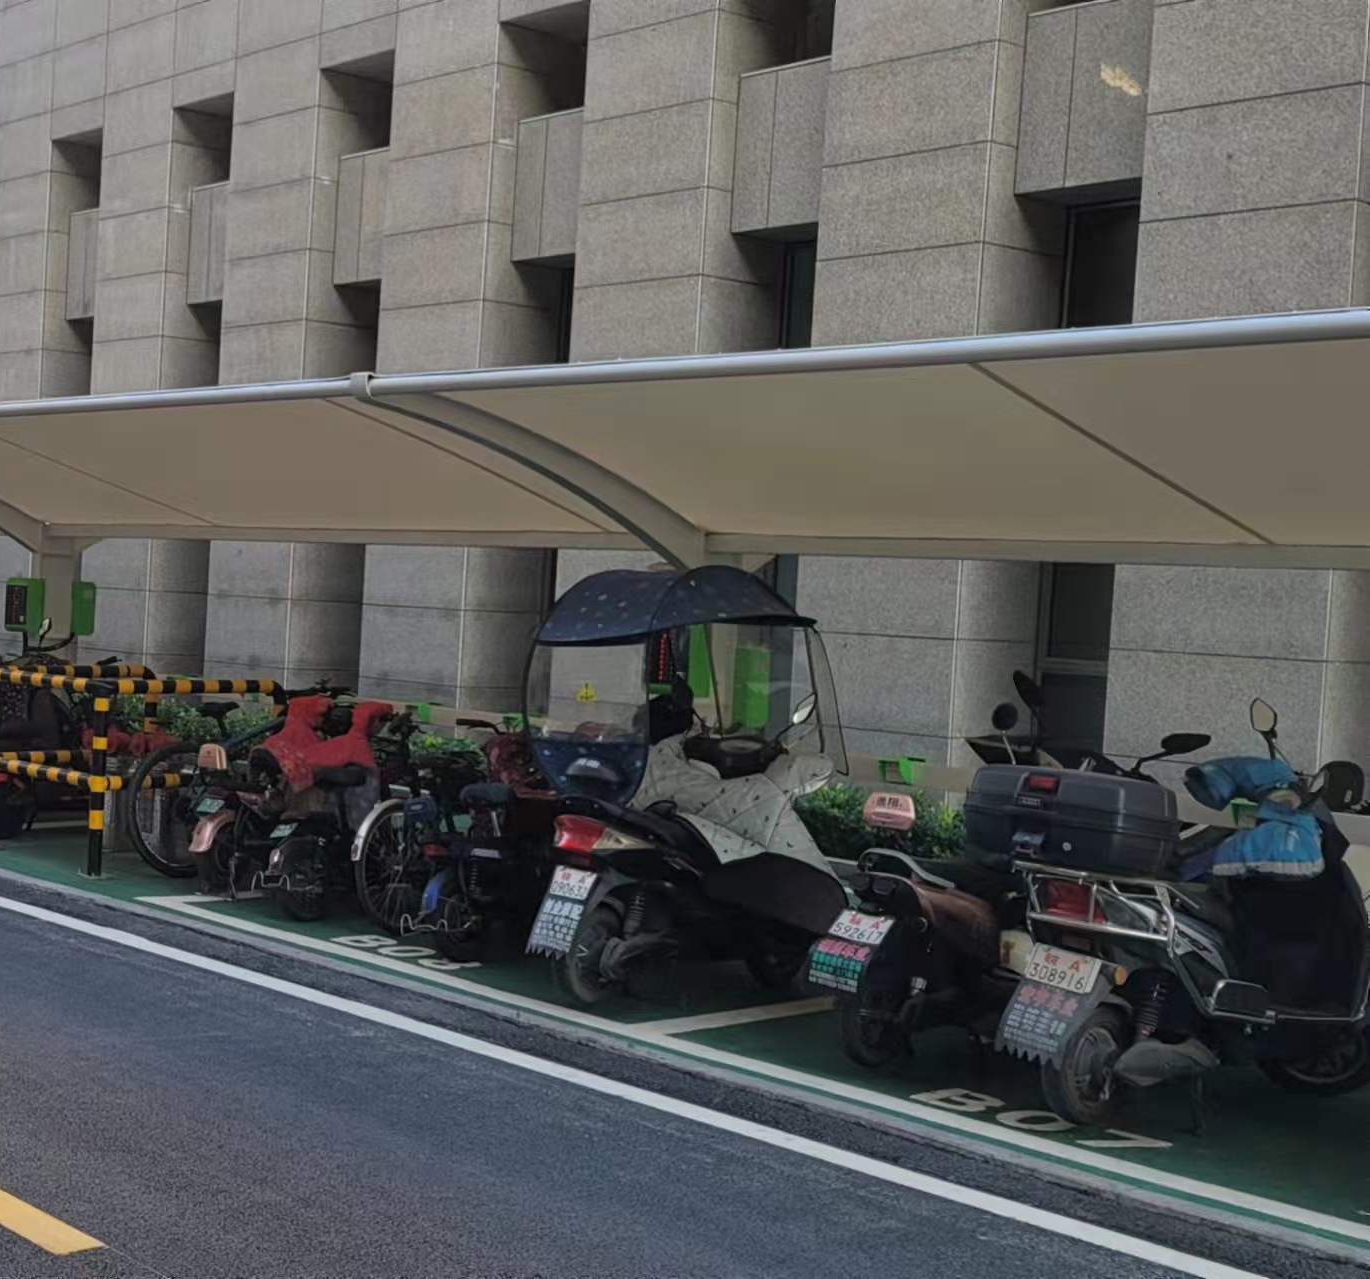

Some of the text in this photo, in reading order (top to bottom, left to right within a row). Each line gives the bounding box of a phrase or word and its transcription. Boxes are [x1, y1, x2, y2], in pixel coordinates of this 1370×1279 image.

[833, 922, 884, 943] 592617
[1029, 962, 1087, 991] 308916
[1069, 960, 1080, 973] A
[909, 1087, 1174, 1148] B07
